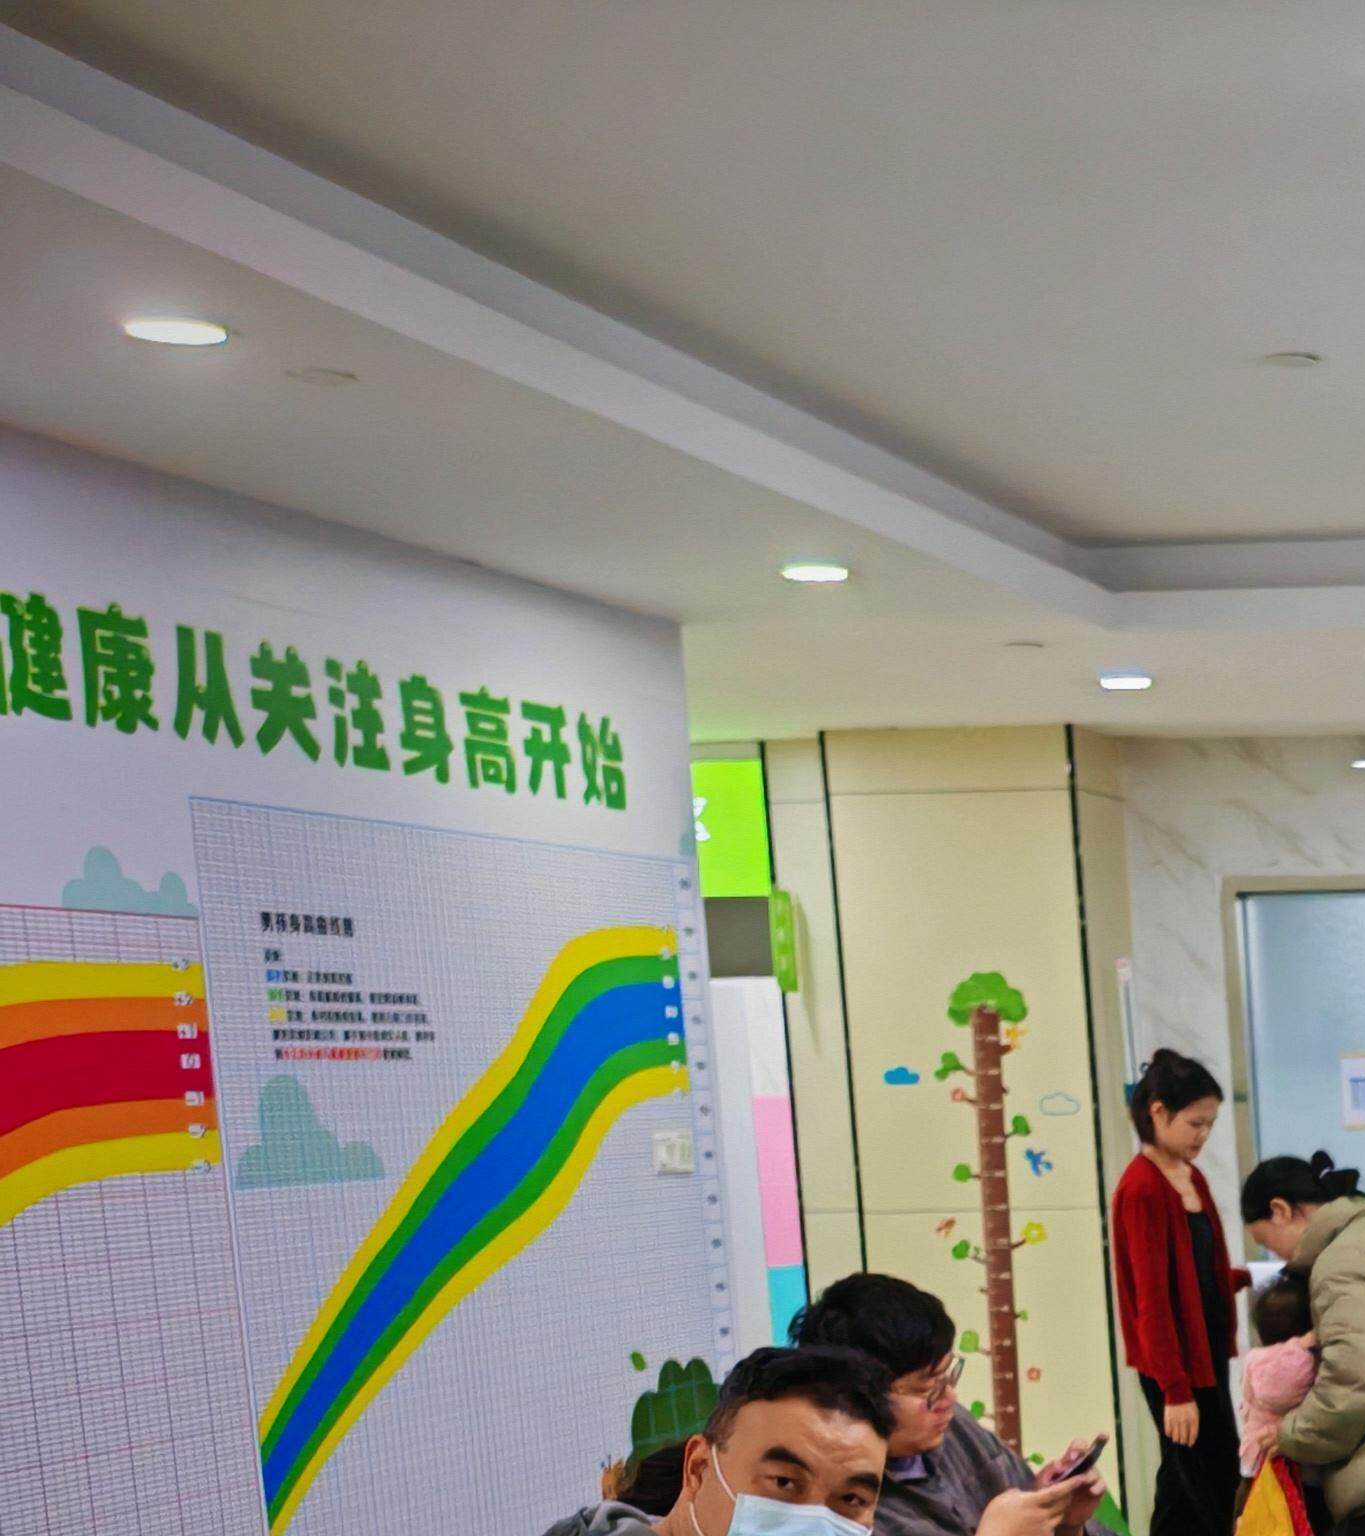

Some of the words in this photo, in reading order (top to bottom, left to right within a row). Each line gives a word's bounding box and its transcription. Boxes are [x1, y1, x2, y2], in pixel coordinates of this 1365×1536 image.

[0, 592, 627, 811] 健康从关注身高开始
